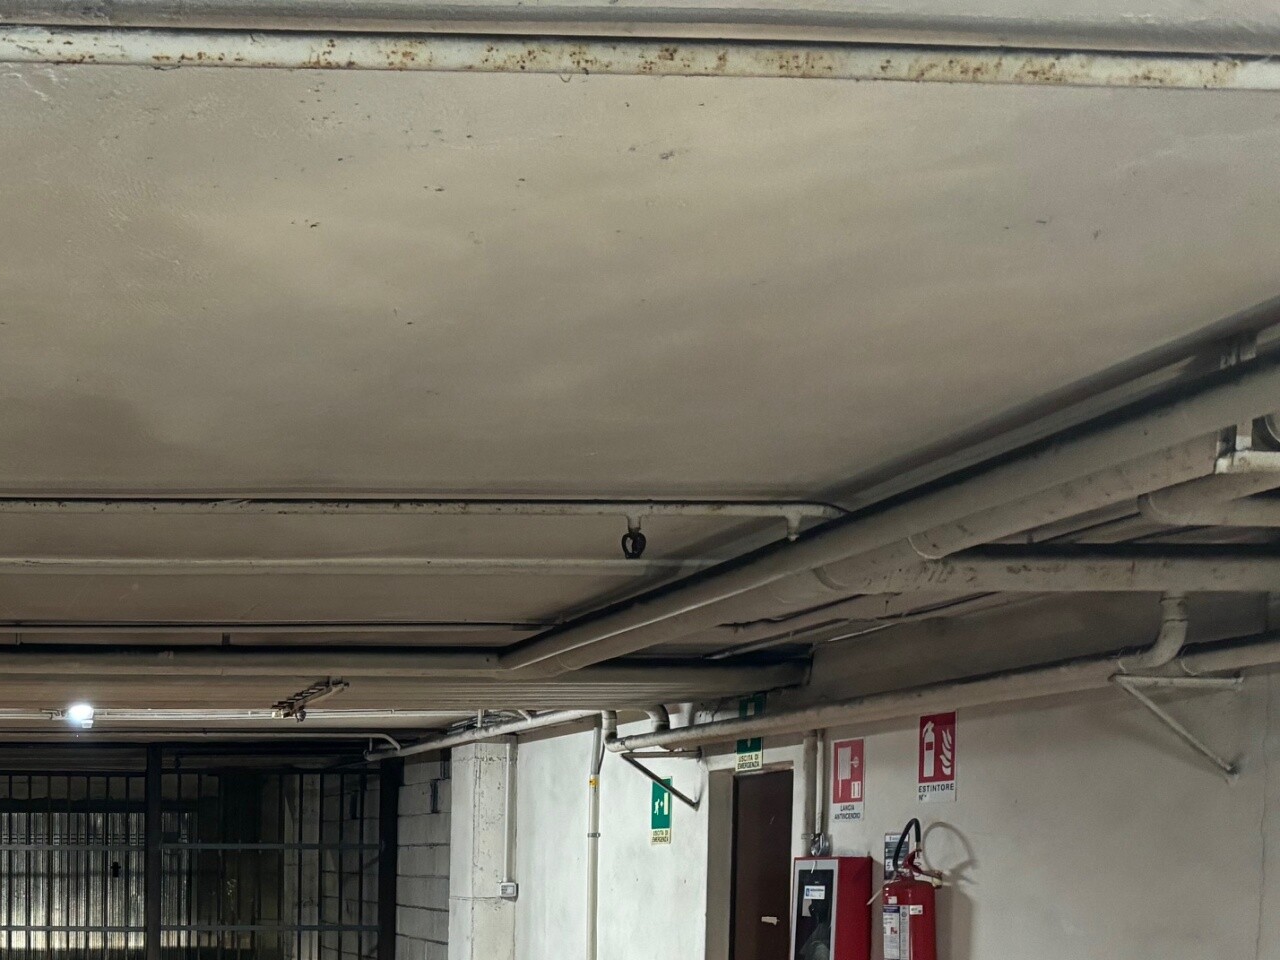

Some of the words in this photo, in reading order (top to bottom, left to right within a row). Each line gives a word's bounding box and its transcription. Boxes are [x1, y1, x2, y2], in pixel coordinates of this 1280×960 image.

[738, 755, 753, 763] USCITA
[737, 761, 760, 770] EMERGENZA
[918, 783, 954, 793] ESTINTORE
[834, 812, 860, 820] ANTINCENDIO
